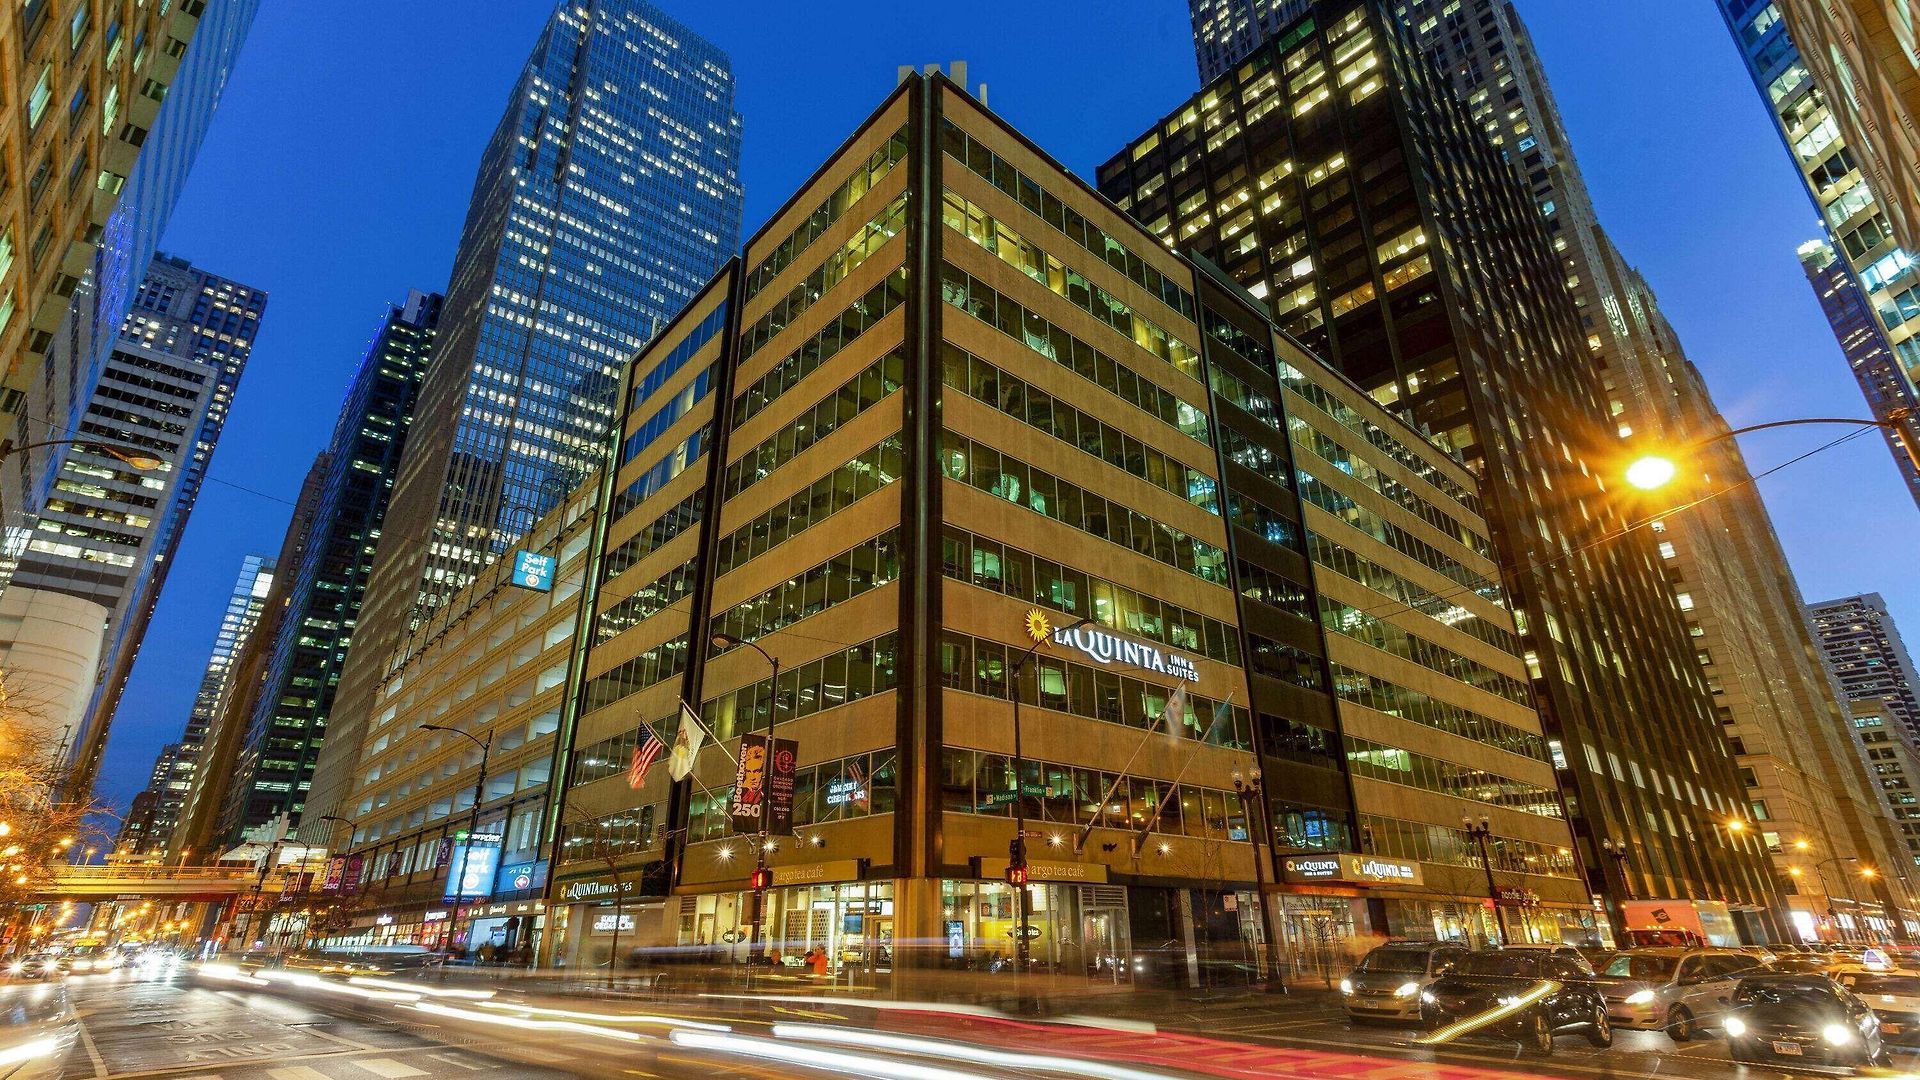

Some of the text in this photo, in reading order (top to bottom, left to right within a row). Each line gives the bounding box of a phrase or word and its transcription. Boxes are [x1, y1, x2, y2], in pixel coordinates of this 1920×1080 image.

[525, 552, 549, 566] Self
[521, 562, 547, 577] Park
[1053, 626, 1165, 673] LA QUINTA
[1170, 654, 1194, 670] INN &
[1167, 665, 1199, 682] SUITES
[734, 743, 748, 803] Beethoven
[732, 803, 761, 817] 250
[794, 868, 805, 880] tea
[806, 864, 824, 879] café
[1031, 865, 1053, 878] argo
[1053, 865, 1066, 876] tea
[1067, 864, 1085, 877] café
[1303, 861, 1339, 872] QUINTA
[1362, 860, 1400, 878] LA QUINTA
[573, 882, 599, 900] QUINTA
[164, 1030, 253, 1044] BUS
[180, 1043, 298, 1061] ONLY
